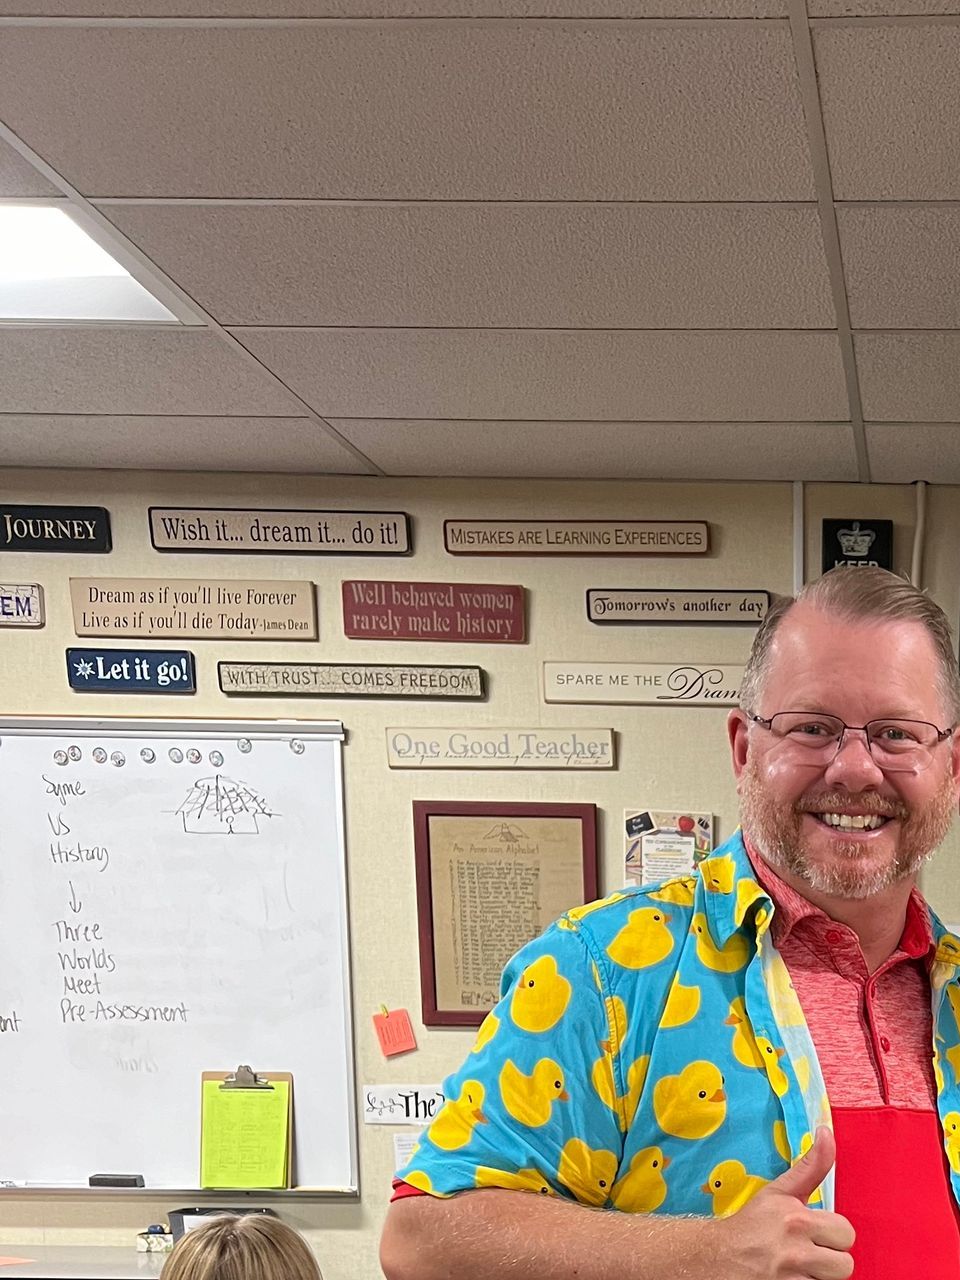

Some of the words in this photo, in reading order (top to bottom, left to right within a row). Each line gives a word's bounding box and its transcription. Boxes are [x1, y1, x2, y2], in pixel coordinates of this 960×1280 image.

[4, 514, 97, 544] JOURNEY
[161, 517, 209, 542] Wish
[214, 522, 244, 543] it...
[250, 519, 313, 544] dream
[317, 522, 346, 544] it...
[352, 522, 375, 545] do
[379, 522, 399, 545] it!
[450, 528, 515, 545] MISTAKES
[518, 531, 543, 546] ARE
[546, 528, 611, 546] LEARNING
[615, 529, 702, 546] EXPERIENCES
[89, 586, 135, 605] Dream
[140, 591, 155, 605] as
[159, 587, 171, 605] if
[173, 586, 213, 609] you'll
[217, 587, 243, 606] live
[246, 588, 298, 607] Forever
[351, 584, 389, 605] Well
[392, 584, 456, 608] behaved
[459, 588, 515, 611] women
[594, 595, 676, 615] Tomorrow's
[682, 597, 732, 614] another
[738, 598, 765, 618] day
[82, 611, 111, 630] Live
[114, 616, 129, 630] as
[132, 612, 144, 630] if
[148, 611, 188, 634] you'll
[191, 612, 213, 631] die
[217, 613, 260, 635] Today
[351, 612, 401, 637] rarely
[408, 612, 451, 634] make
[456, 612, 514, 639] history
[96, 657, 132, 681] Let
[134, 657, 151, 681] it
[157, 657, 189, 687] go!
[227, 670, 267, 685] WITH
[341, 671, 395, 687] COMES
[400, 673, 473, 690] FREEDOM
[556, 674, 604, 686] SPARE
[608, 674, 630, 686] ME
[634, 674, 662, 686] THE
[656, 666, 742, 700] Dram
[392, 733, 441, 755] One
[448, 733, 511, 755] Good
[518, 733, 609, 756] Teacher
[47, 812, 72, 837] US
[50, 843, 111, 873] History
[52, 921, 104, 943] Three
[57, 948, 117, 973] Worlds
[63, 976, 102, 996] Meet
[60, 998, 190, 1024] Pre-Assessment
